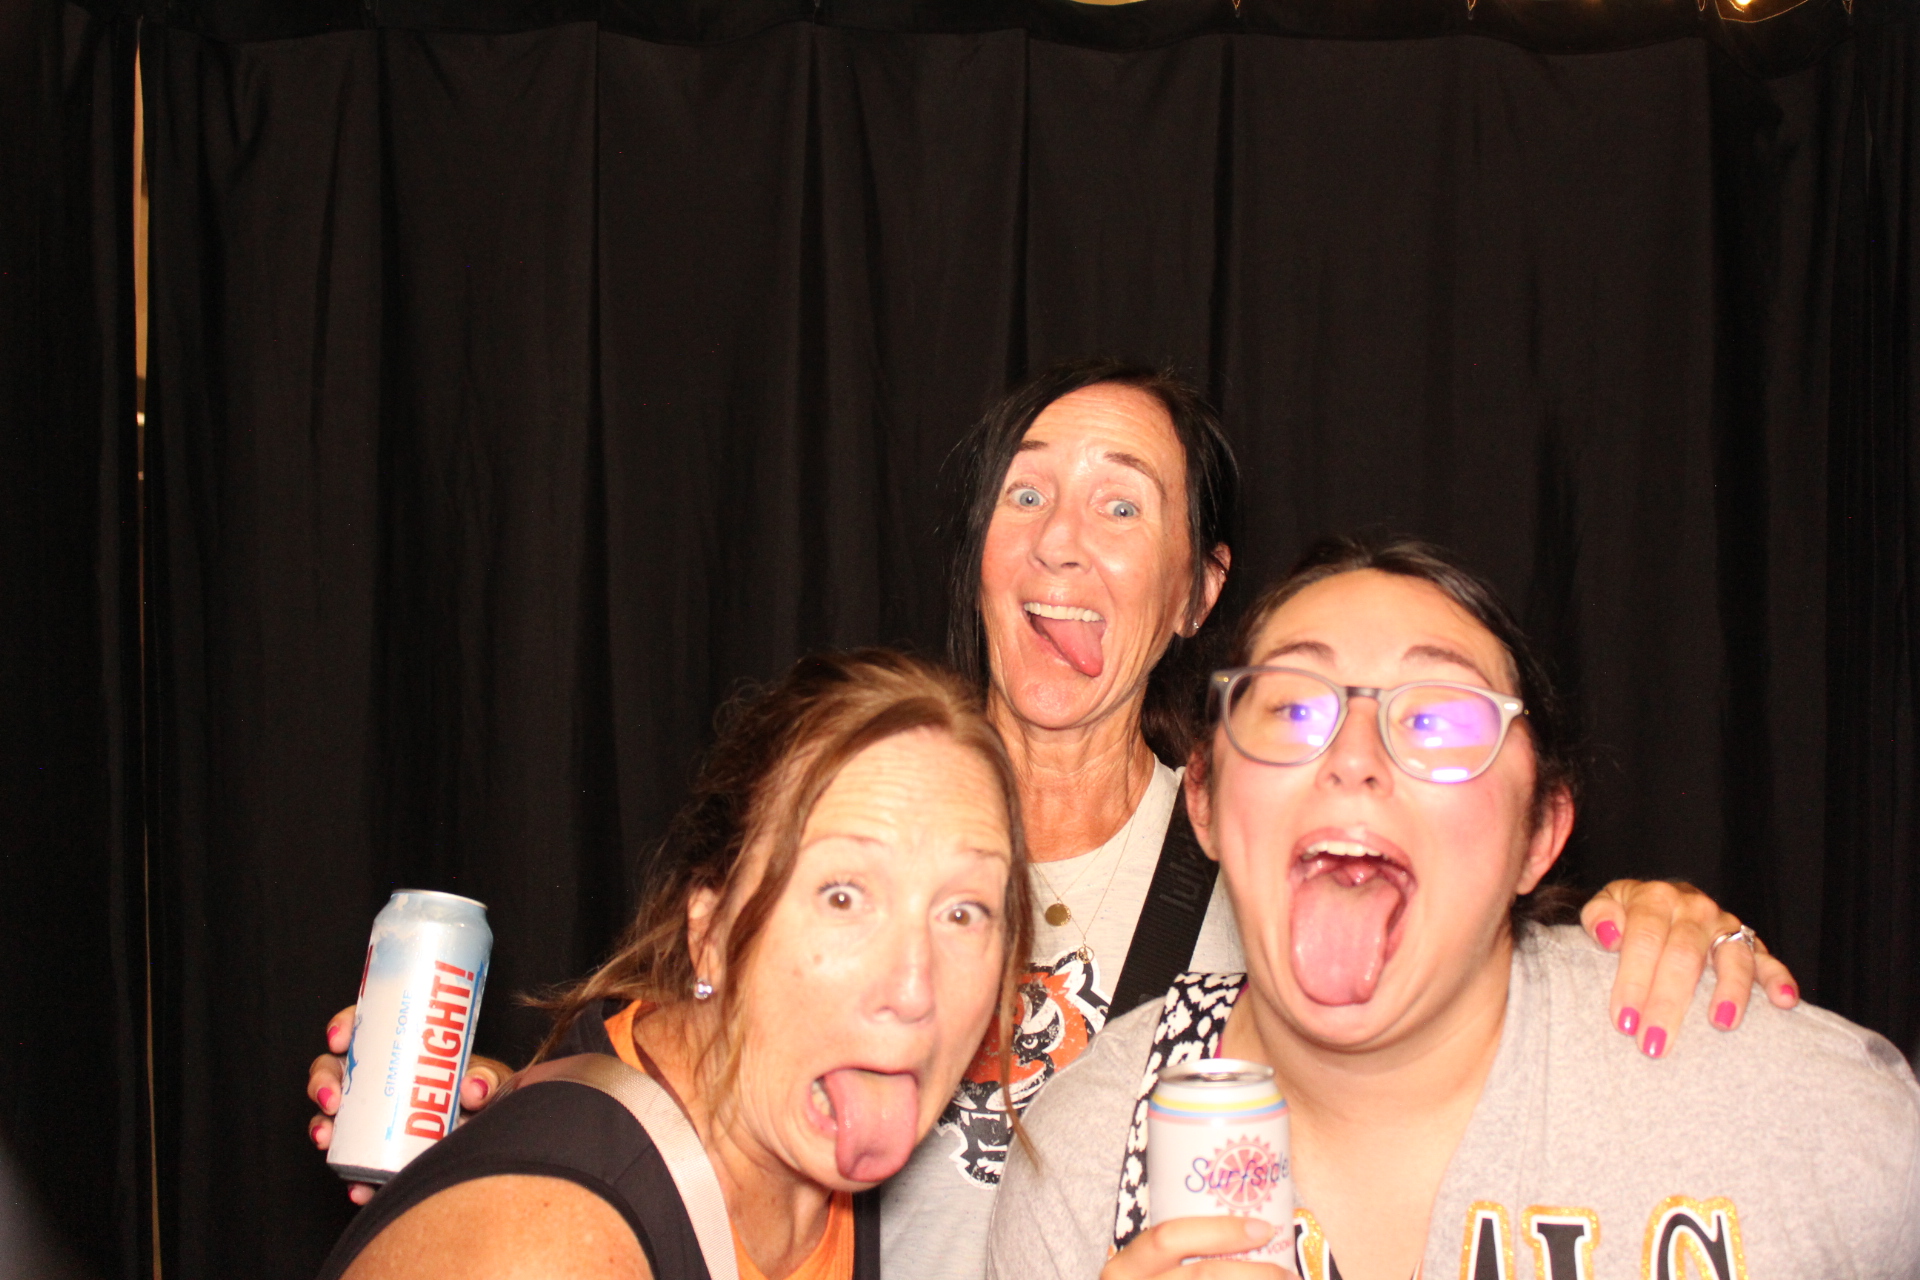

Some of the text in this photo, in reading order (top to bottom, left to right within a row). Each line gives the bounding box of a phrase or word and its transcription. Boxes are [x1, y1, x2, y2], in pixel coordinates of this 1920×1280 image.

[384, 989, 414, 1098] GIMME SOME
[404, 959, 475, 1141] DELIGHT!
[1185, 1153, 1290, 1193] Surfside
